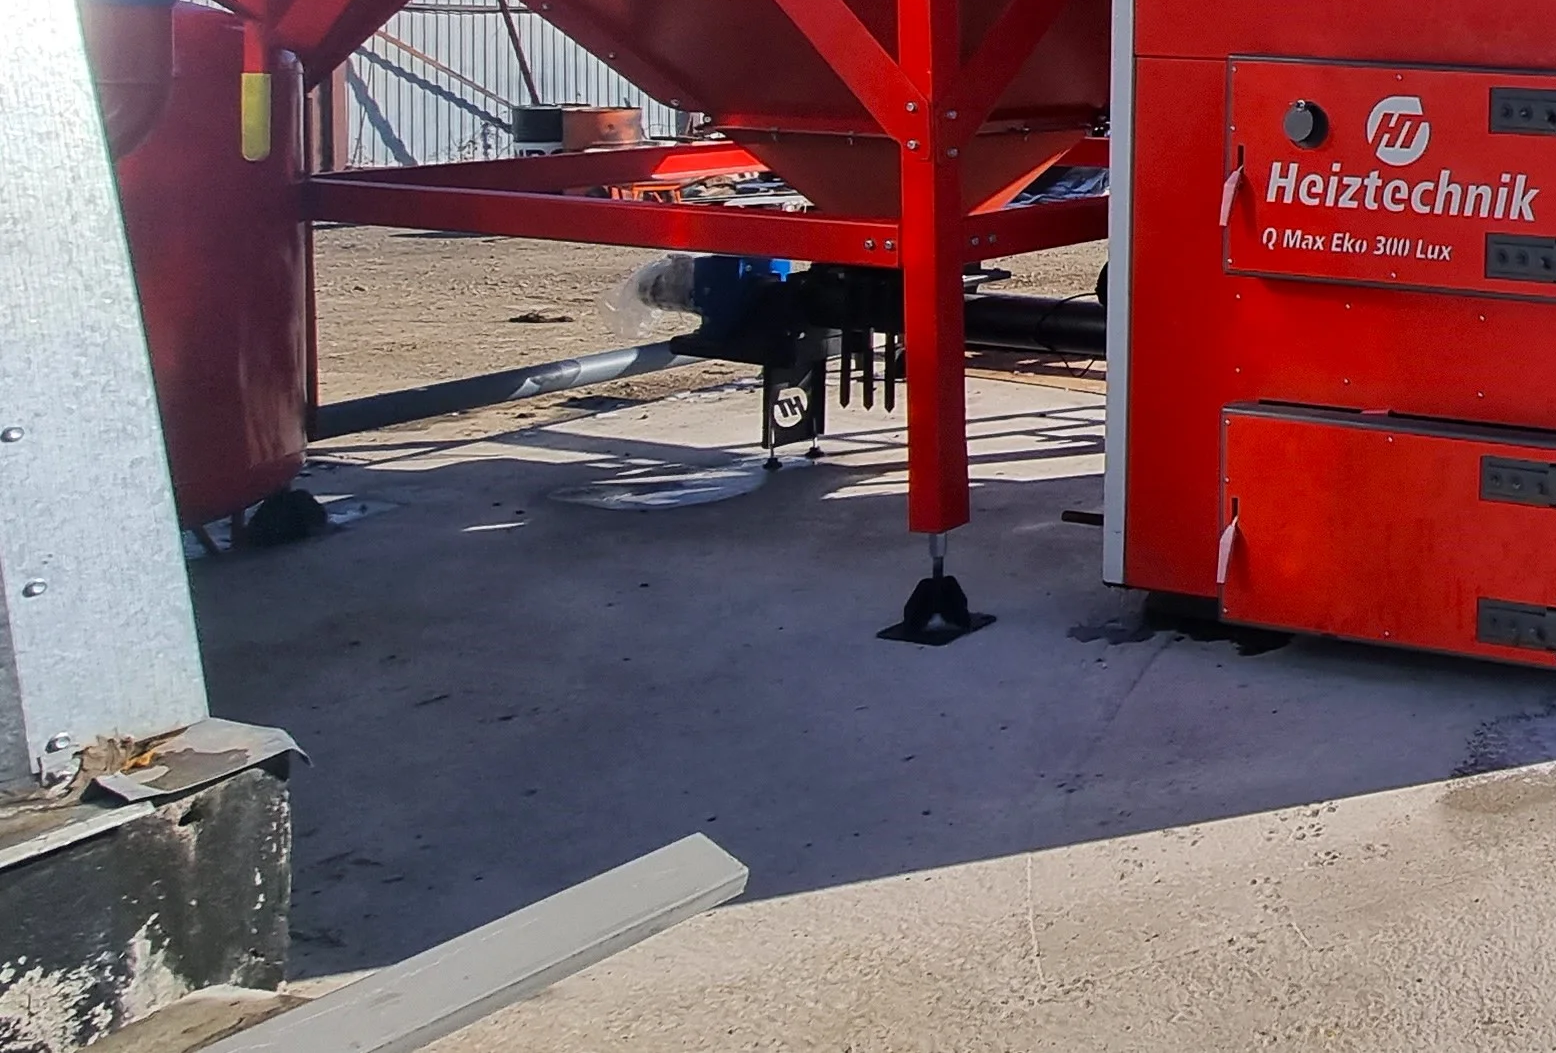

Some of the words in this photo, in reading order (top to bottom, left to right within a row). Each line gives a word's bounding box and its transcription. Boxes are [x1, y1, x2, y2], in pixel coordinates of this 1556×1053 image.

[1266, 161, 1539, 221] Heiztechnik
[1262, 227, 1277, 250] Q
[1283, 229, 1326, 250] Max
[1331, 232, 1367, 254] Eko
[1373, 235, 1410, 257] 300
[1416, 239, 1452, 261] Lux
